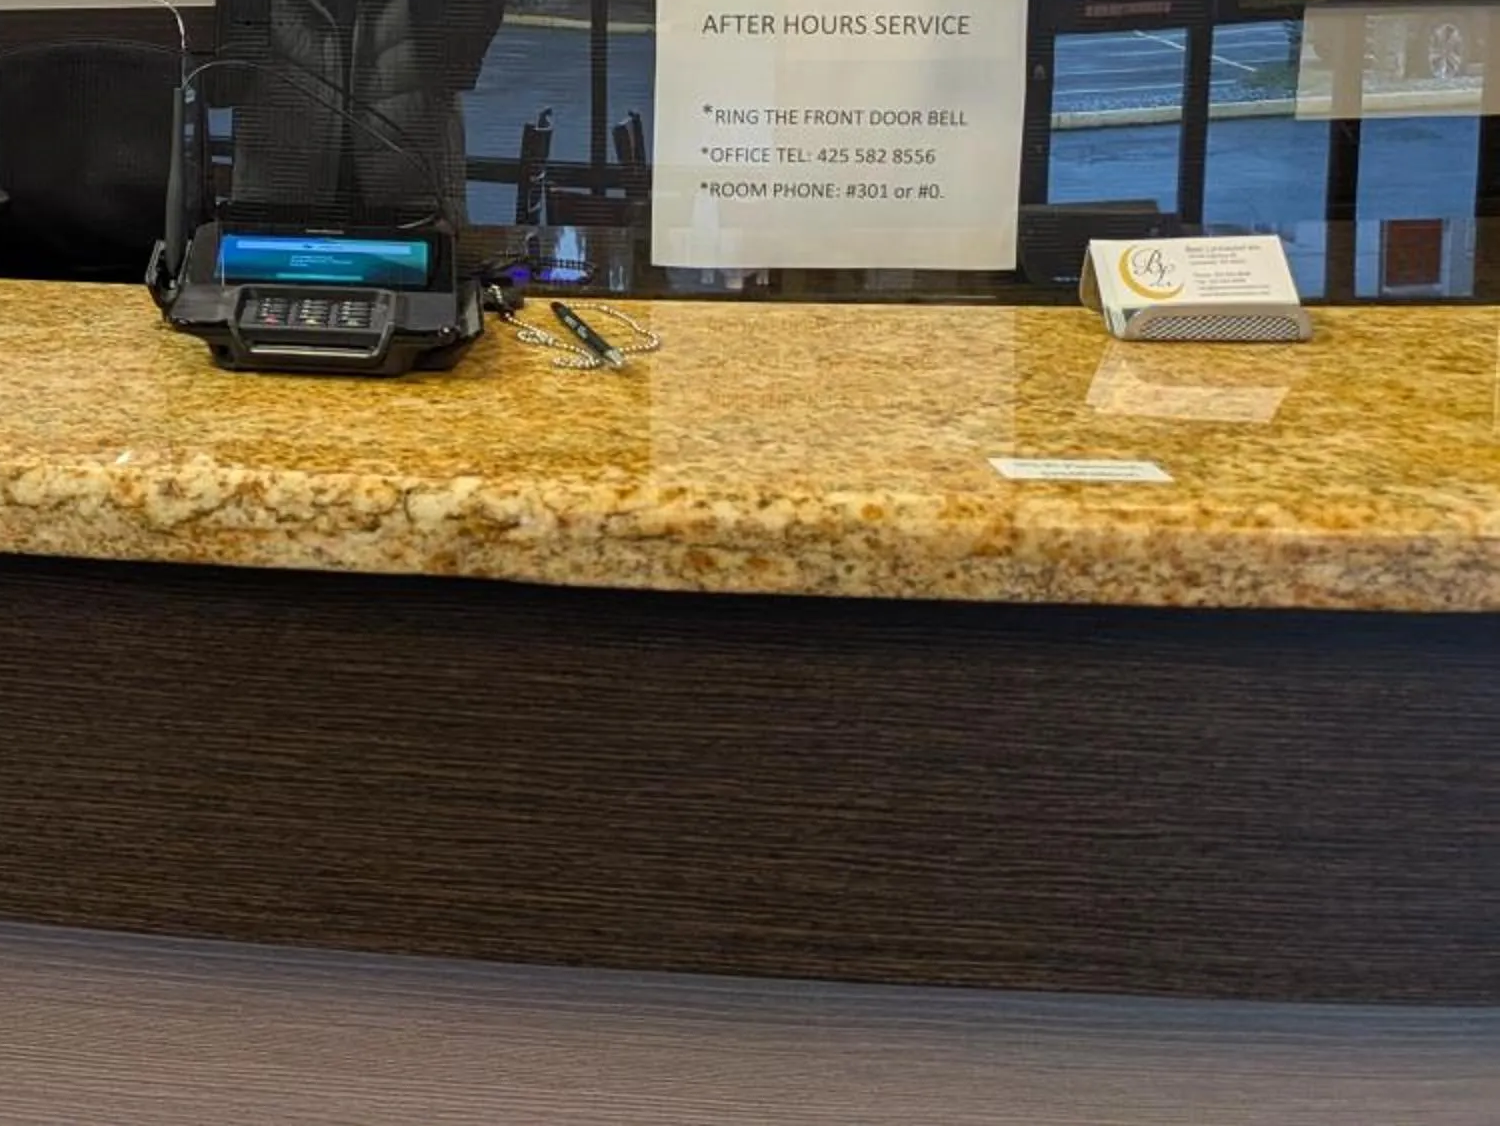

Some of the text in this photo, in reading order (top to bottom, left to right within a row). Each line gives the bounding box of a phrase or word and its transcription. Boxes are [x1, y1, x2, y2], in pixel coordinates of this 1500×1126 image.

[702, 14, 971, 37] AFTER HOURS SERVICE
[765, 109, 798, 127] THE
[803, 109, 864, 127] FRONT
[869, 110, 923, 127] DOOR
[927, 110, 968, 127] BELL
[776, 147, 812, 165] TEL:
[816, 148, 851, 165] 425
[855, 148, 887, 165] 582
[891, 148, 936, 165] 8556
[773, 182, 842, 200] PHONE:
[845, 182, 889, 200] #301
[893, 186, 913, 200] or
[917, 183, 944, 201] #0.
